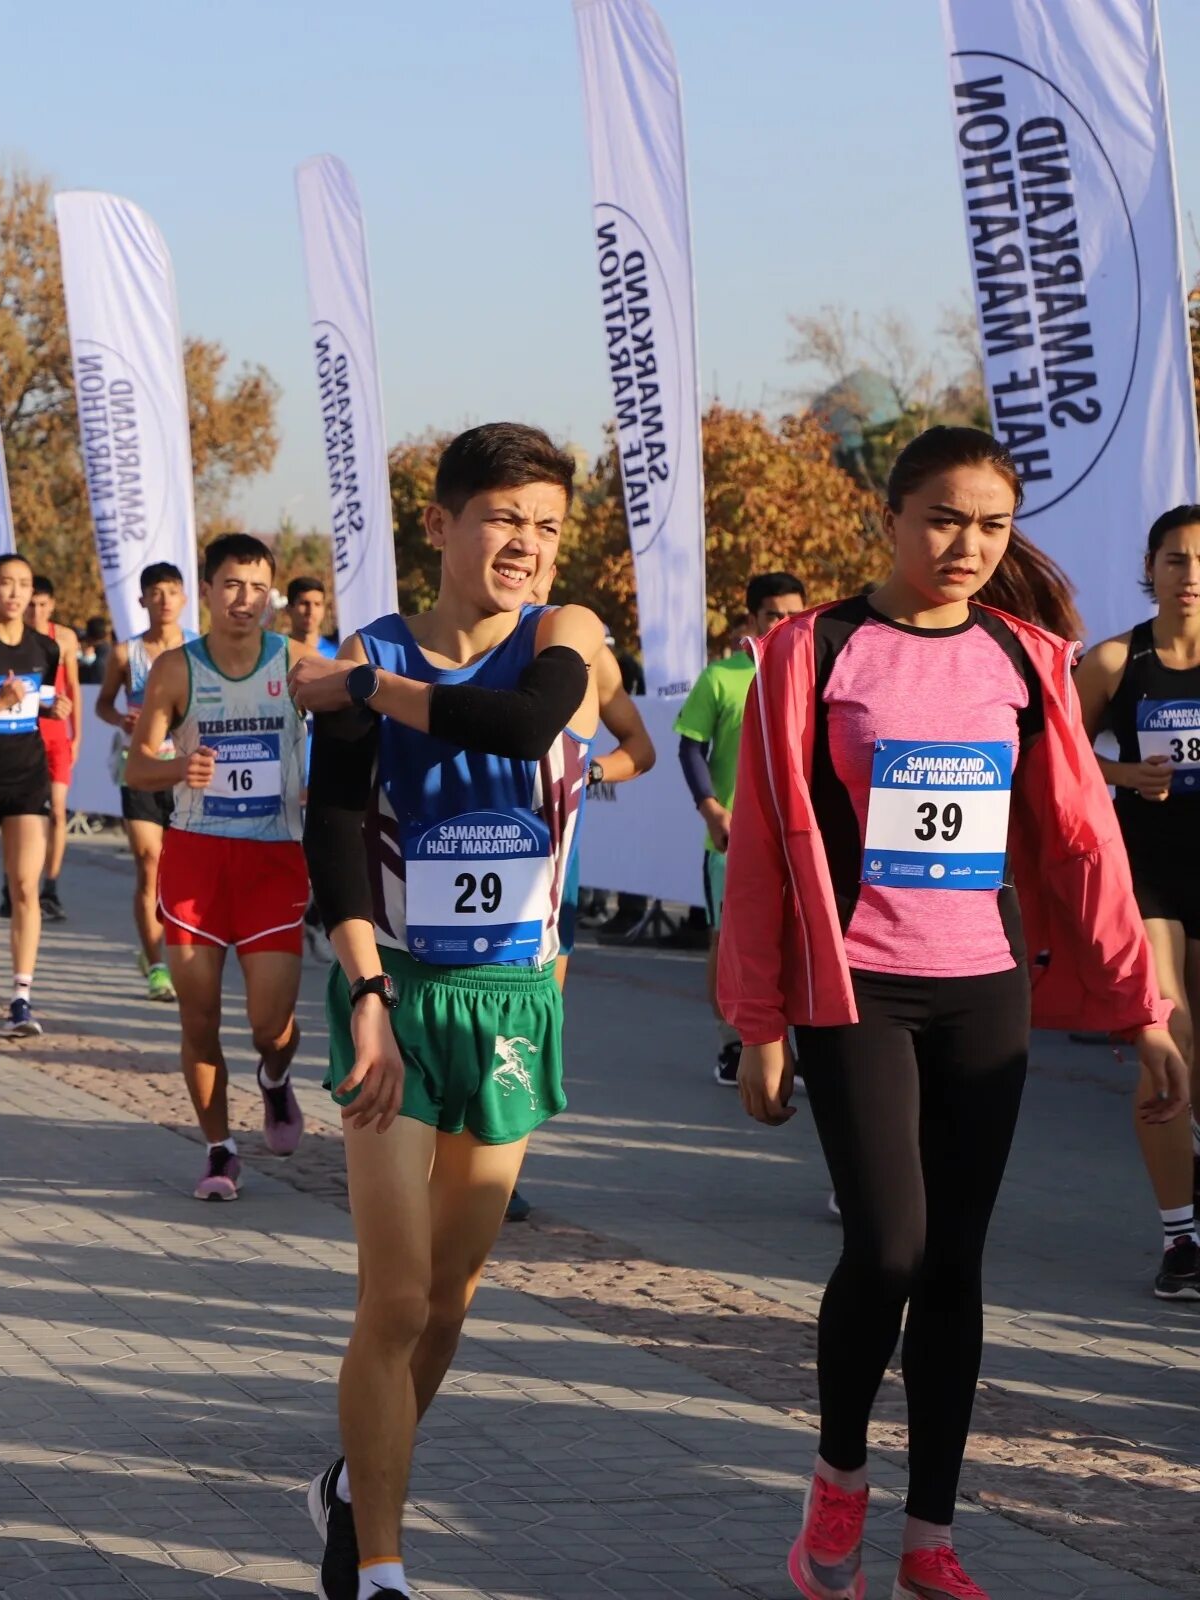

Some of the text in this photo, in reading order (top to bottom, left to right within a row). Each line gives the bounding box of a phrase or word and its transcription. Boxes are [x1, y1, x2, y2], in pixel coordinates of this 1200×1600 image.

[1157, 708, 1200, 719] SAMARKA
[198, 716, 284, 735] UZBEKISTAN
[1150, 718, 1200, 729] HALF MARA
[218, 743, 262, 751] SAMARKAND
[1169, 738, 1200, 763] 38
[230, 750, 269, 761] MARATHON
[907, 756, 984, 772] SAMARKAND
[228, 769, 253, 792] 16
[892, 770, 995, 785] HALF MARATHON
[914, 802, 963, 842] 39
[439, 825, 521, 840] SAMARKAND
[427, 839, 532, 854] HALF MARATHON
[454, 872, 502, 914] 29
